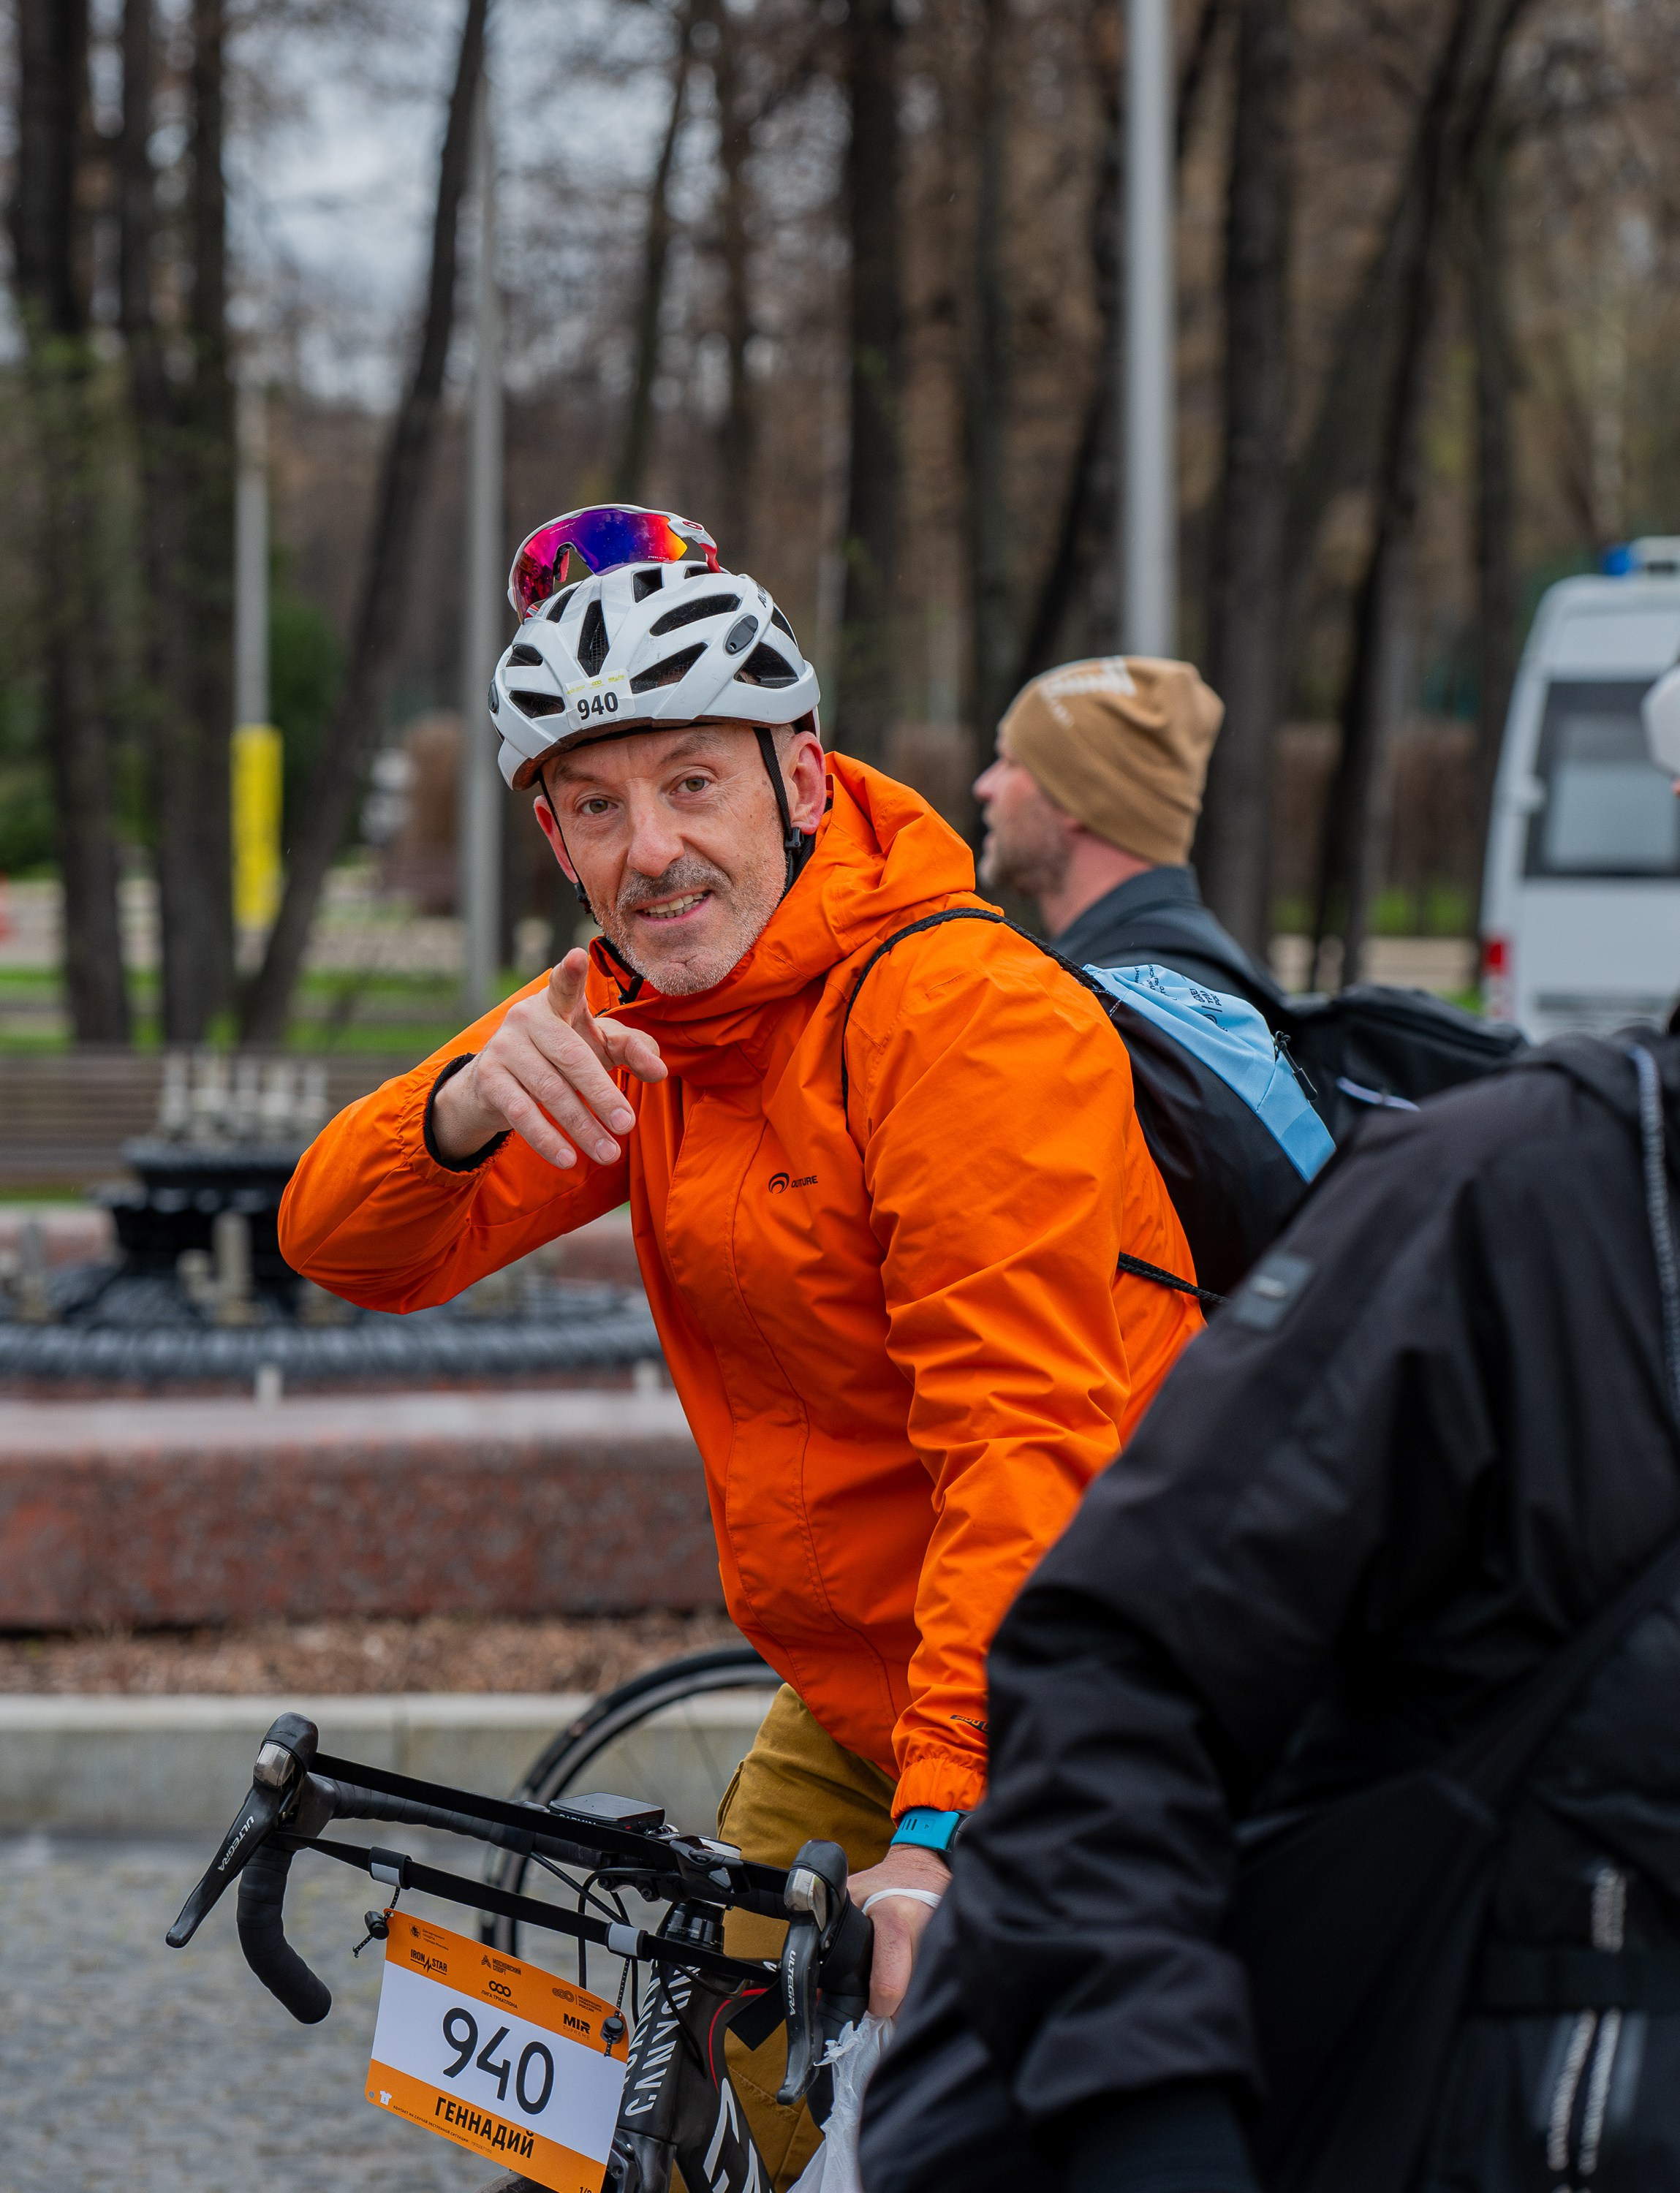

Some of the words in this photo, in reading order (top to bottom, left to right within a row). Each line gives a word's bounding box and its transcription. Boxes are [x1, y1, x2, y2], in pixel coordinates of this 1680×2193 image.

[577, 692, 618, 721] 940
[218, 1815, 254, 1871] ULTEGRA
[410, 1949, 425, 1963] IRON
[431, 1958, 447, 1972] STAR
[787, 1950, 796, 2016] ULTEGRA
[481, 1990, 493, 1999] ЛИГА
[493, 1994, 518, 2009] ТРИАТЛОНА
[562, 2025, 590, 2039] SUPREME
[563, 2013, 591, 2034] MIR
[442, 2007, 554, 2115] 940
[434, 2096, 534, 2159] ГЕННАДИЙ
